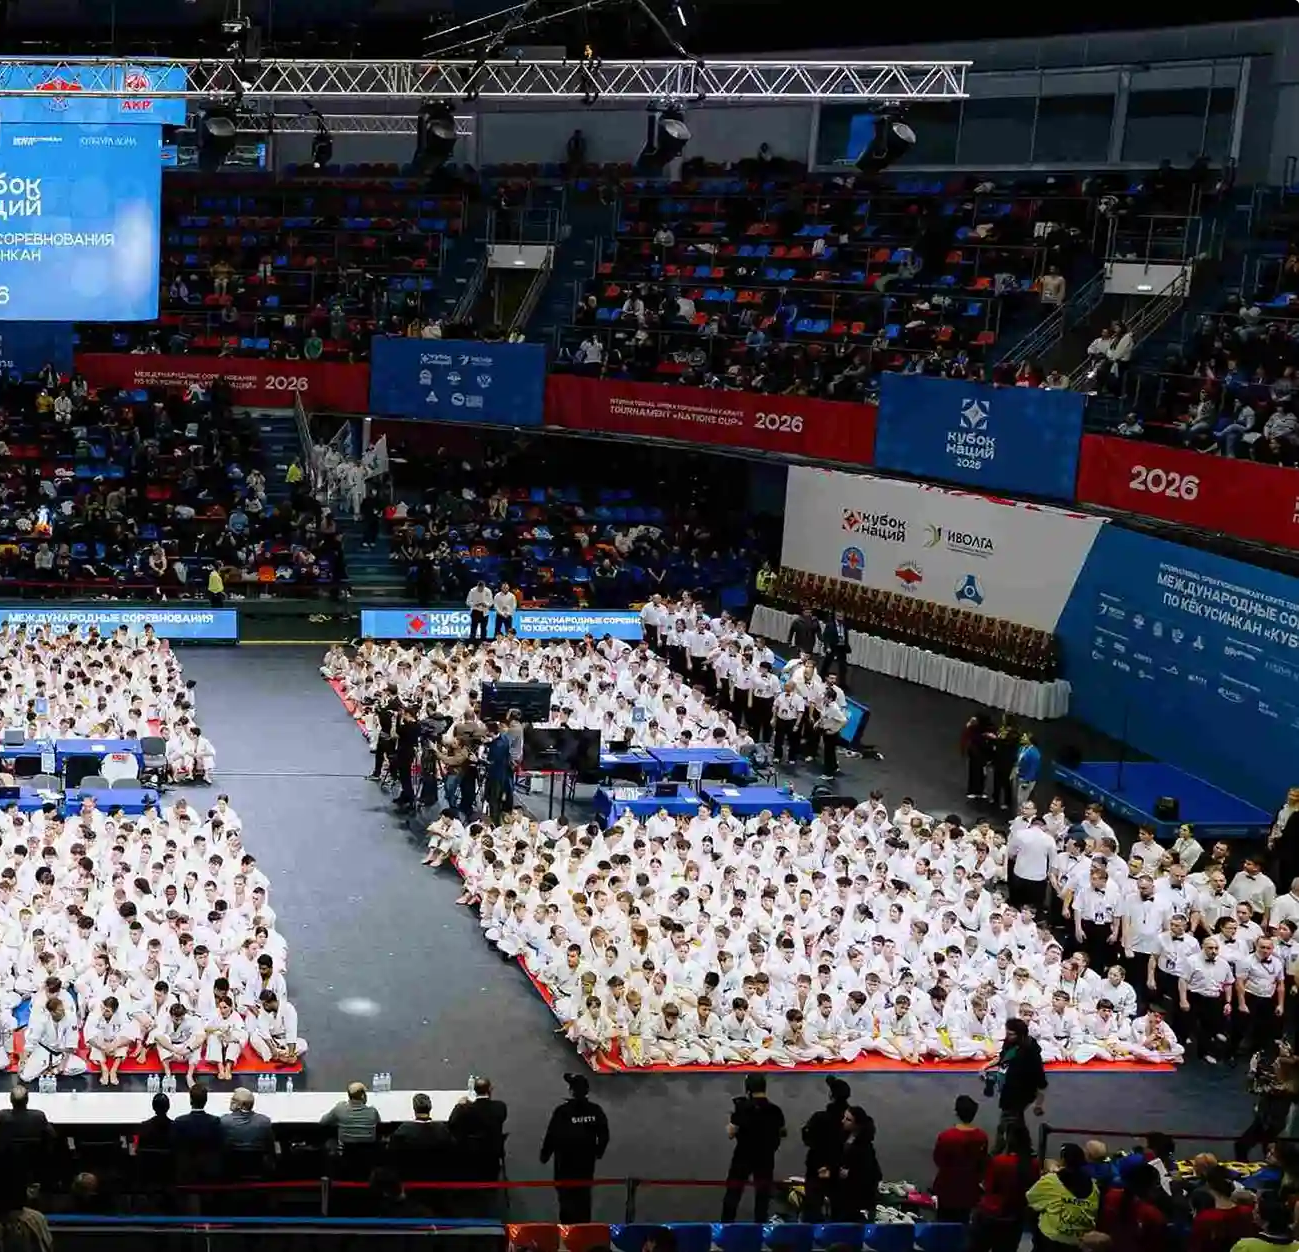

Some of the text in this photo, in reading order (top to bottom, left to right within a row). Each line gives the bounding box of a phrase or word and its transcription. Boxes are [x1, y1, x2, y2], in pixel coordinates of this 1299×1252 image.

[264, 375, 309, 391] 2026
[610, 406, 670, 418] TOURNAMENT
[753, 412, 803, 433] 2026
[947, 431, 997, 446] кубок
[946, 443, 994, 460] наций
[957, 457, 981, 470] 2026
[1129, 464, 1201, 500] 2026
[861, 512, 908, 530] кубок
[861, 524, 906, 543] наций
[947, 531, 994, 550] ИВОЛГА
[1157, 572, 1299, 632] МЕЖДУНАРОДНЫЕ СО
[8, 612, 214, 624] МЕЖДУНАРОДНЫЕ СОРЕВНОВАНИЯ
[430, 612, 471, 625] кубо
[520, 616, 601, 625] МЕЖДУНАРОДНЫЕ
[1163, 592, 1180, 607] ПО
[1264, 628, 1299, 649] «КУБ
[430, 624, 471, 638] наци
